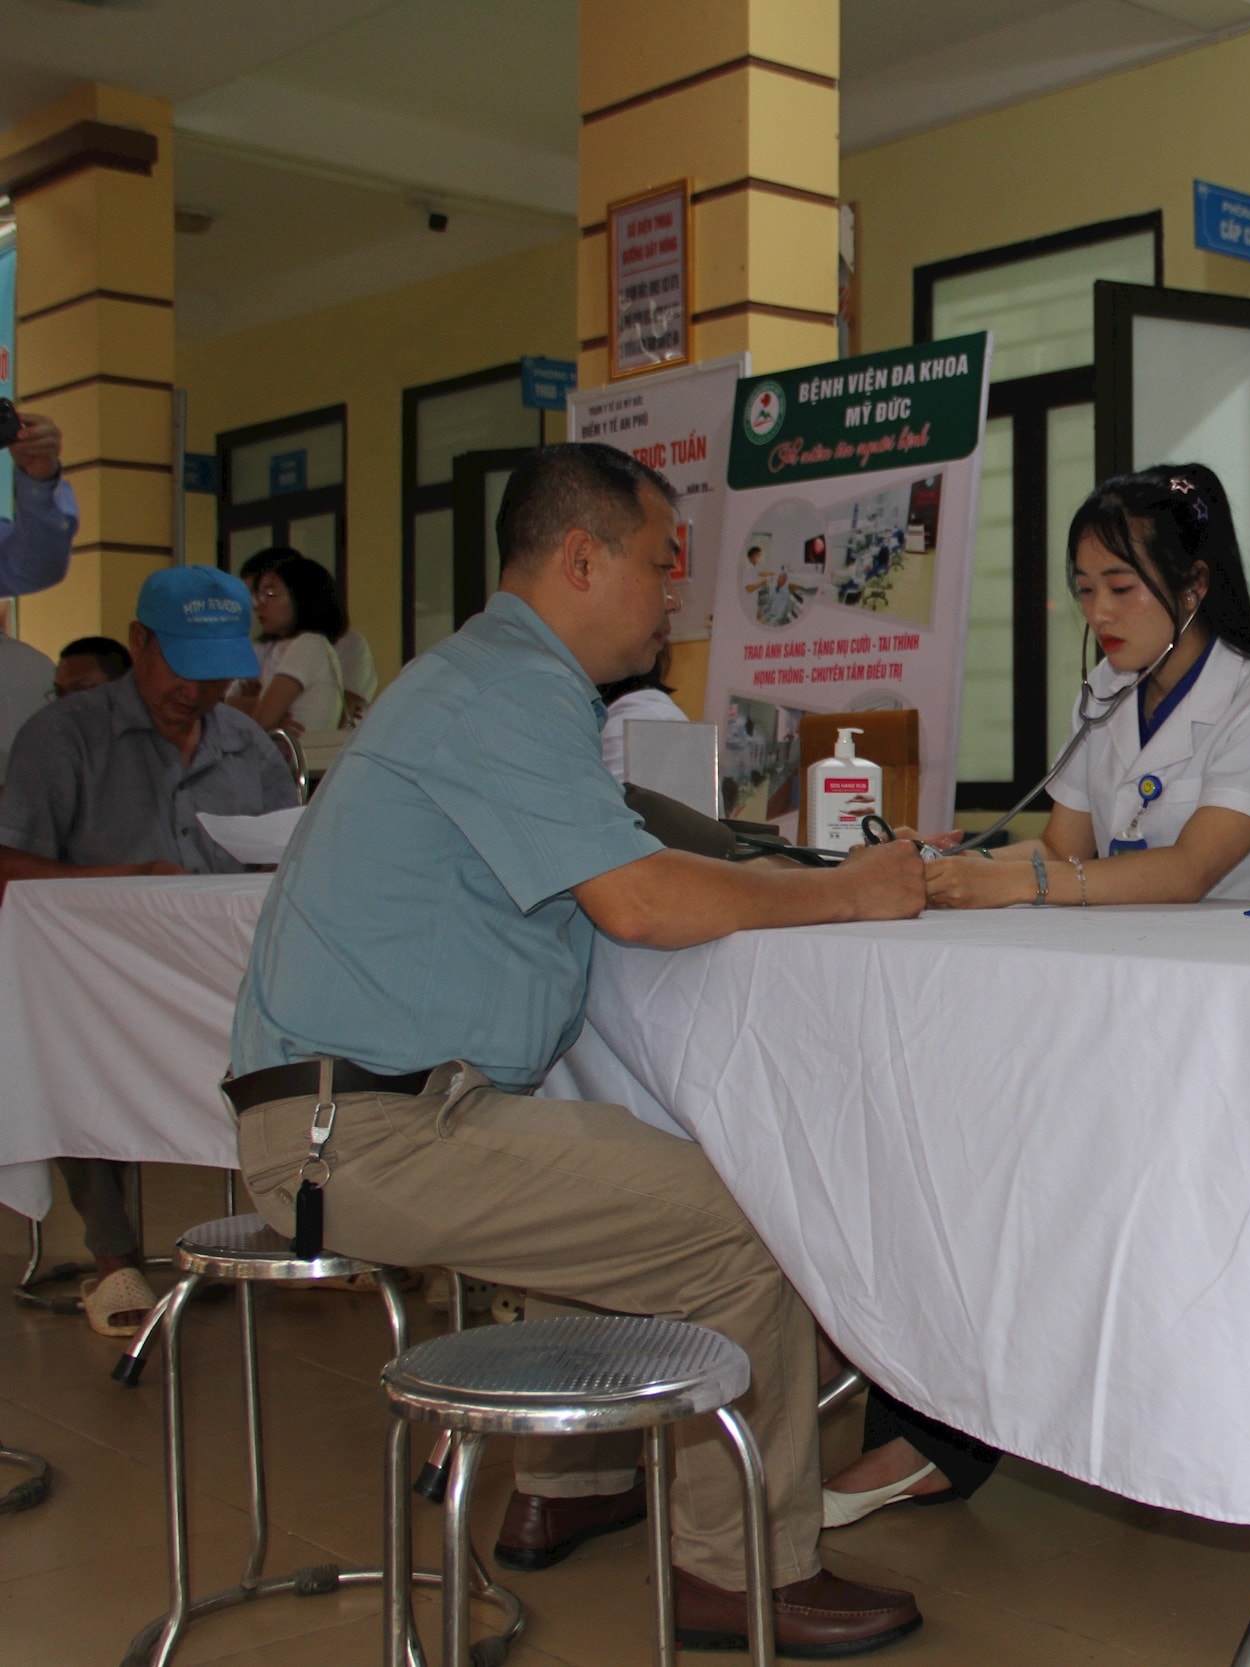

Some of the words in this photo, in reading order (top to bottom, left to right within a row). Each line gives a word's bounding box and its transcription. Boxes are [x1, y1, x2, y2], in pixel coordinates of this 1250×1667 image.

[798, 376, 845, 406] BỆNH
[848, 368, 888, 396] VIỆN
[891, 363, 915, 387] ĐA
[919, 353, 970, 383] KHOA
[845, 400, 872, 429] MỸ
[875, 397, 912, 424] ĐỨC
[784, 640, 806, 659] SÁNG
[879, 636, 892, 651] TAI
